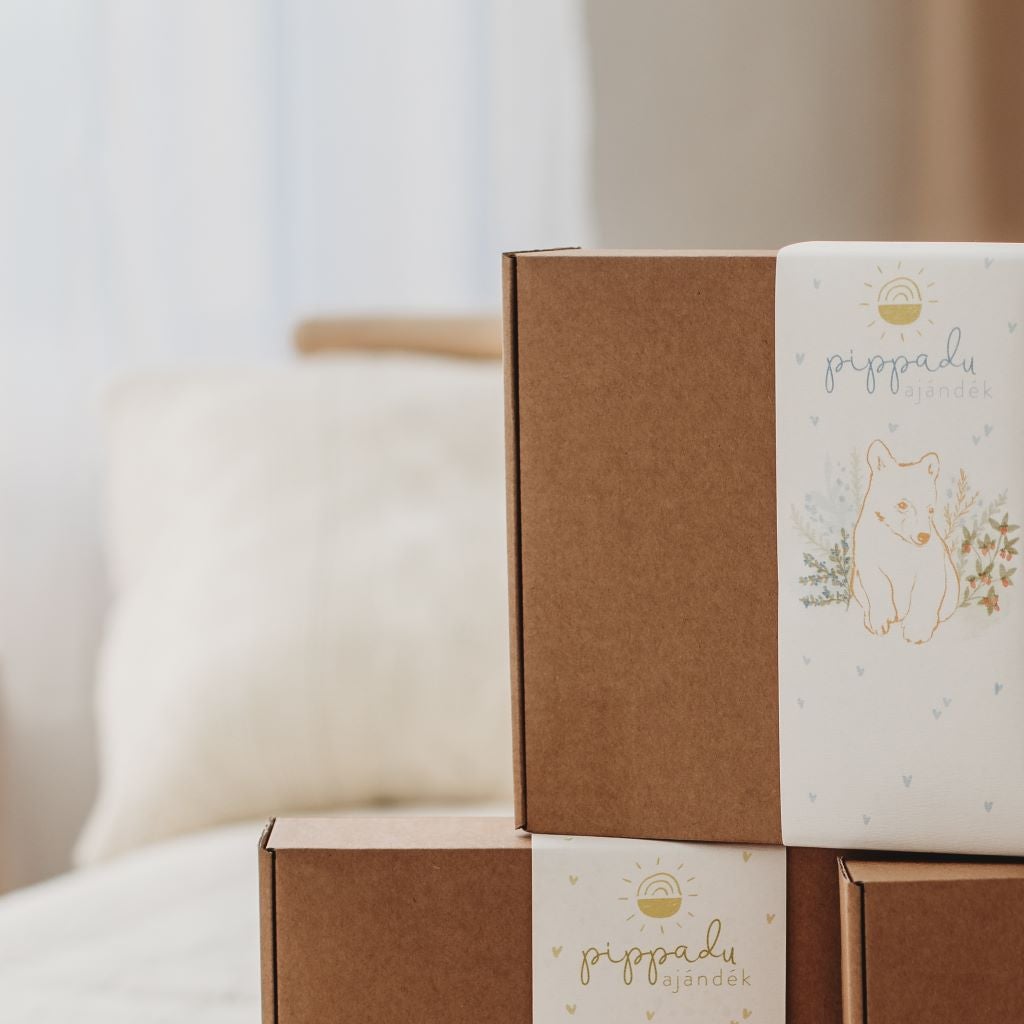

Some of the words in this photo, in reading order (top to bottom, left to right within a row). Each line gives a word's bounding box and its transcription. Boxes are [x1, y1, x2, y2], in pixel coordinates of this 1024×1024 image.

[824, 326, 977, 395] pippadu
[903, 379, 993, 405] ajándék
[580, 918, 737, 986] pippadu
[662, 968, 752, 994] ajándék
